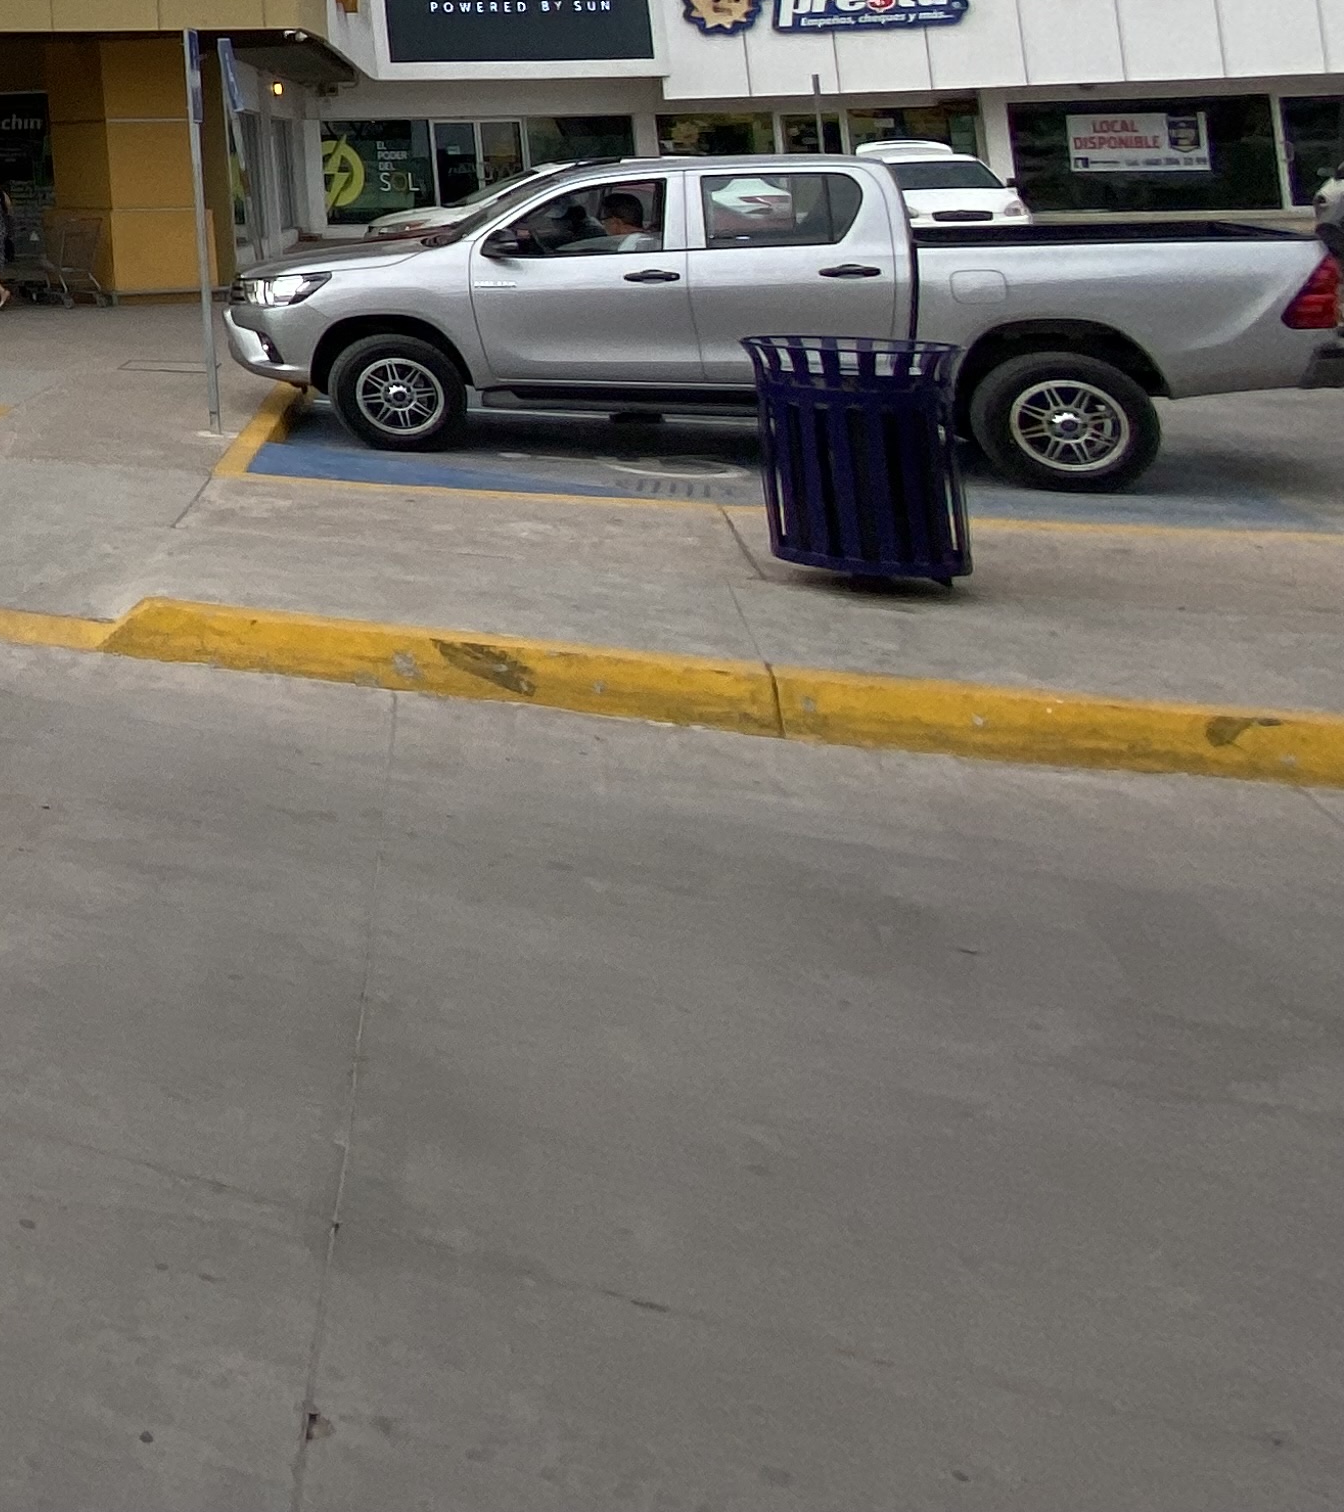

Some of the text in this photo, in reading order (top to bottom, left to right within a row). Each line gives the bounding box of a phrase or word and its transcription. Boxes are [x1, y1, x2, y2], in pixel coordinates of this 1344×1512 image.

[430, 0, 611, 13] POWERED BY SUN
[1092, 120, 1139, 134] LOCAL
[376, 140, 387, 150] EL
[1073, 135, 1161, 150] DISPONIBLE
[377, 150, 408, 160] PODER
[378, 161, 396, 171] DEL
[379, 172, 420, 192] SOL
